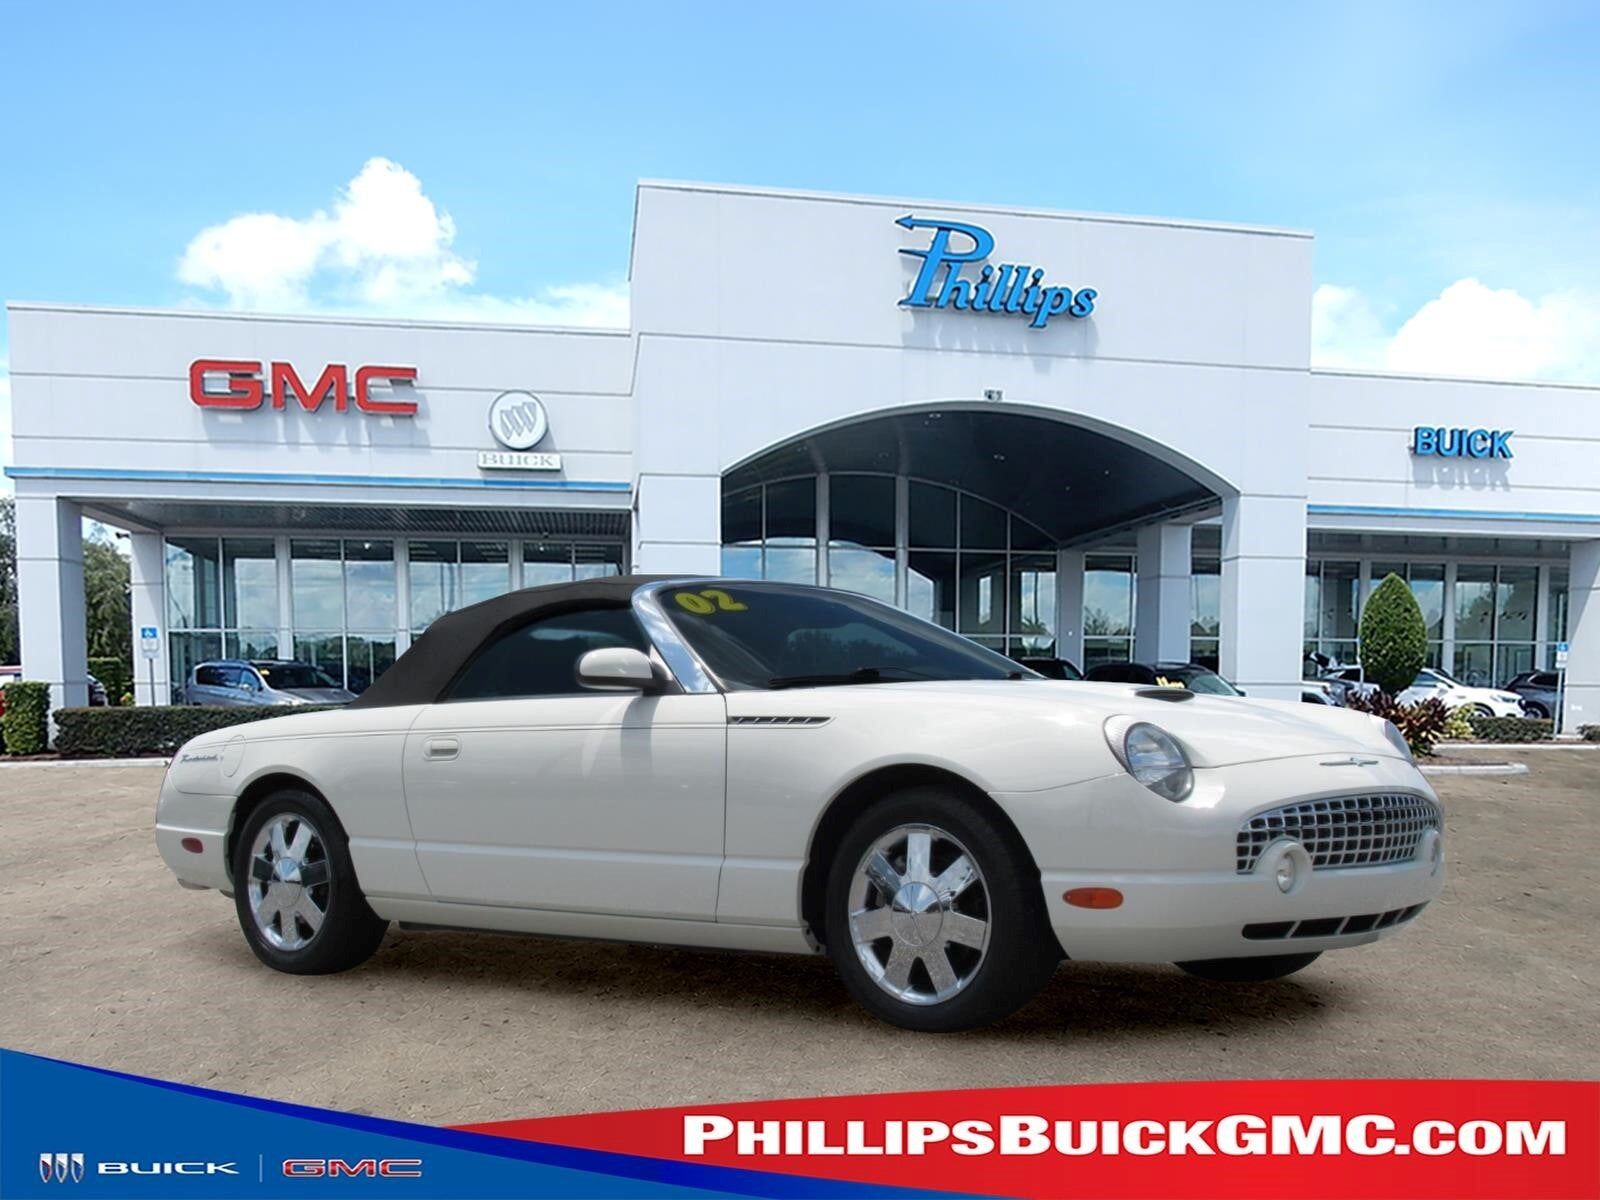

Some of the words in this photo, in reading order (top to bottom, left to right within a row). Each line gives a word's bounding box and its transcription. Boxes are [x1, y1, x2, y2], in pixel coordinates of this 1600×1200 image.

[895, 214, 1098, 329] Phillips
[189, 358, 418, 414] GMC
[1414, 426, 1514, 459] BUICK
[482, 453, 554, 466] BUICK
[674, 589, 749, 615] 02
